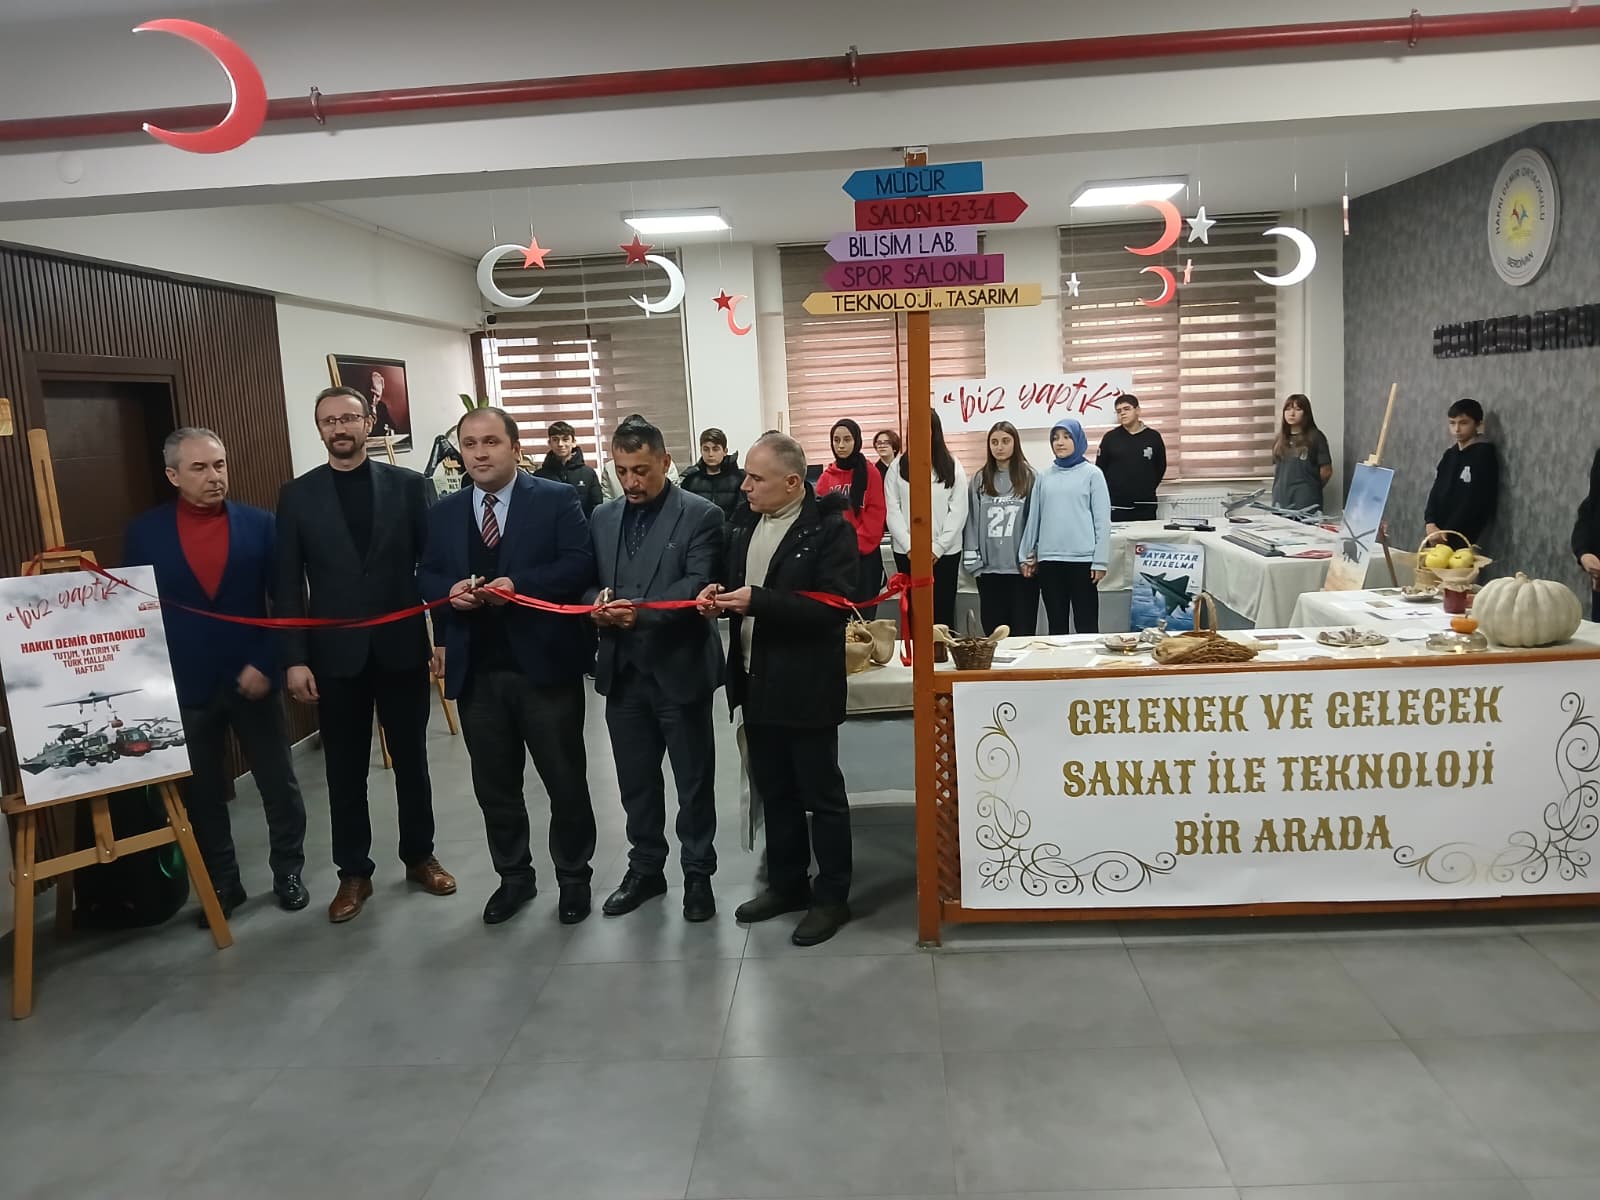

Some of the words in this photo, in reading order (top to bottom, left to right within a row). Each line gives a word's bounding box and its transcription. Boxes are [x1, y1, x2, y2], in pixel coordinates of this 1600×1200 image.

[875, 168, 946, 196] MÜDÜR
[868, 202, 932, 226] SALON
[937, 198, 997, 222] 1-2-3-4
[849, 232, 912, 258] BİLİŞİM
[918, 232, 958, 254] LAB.
[841, 264, 894, 288] SPOR
[903, 260, 988, 284] SALONU
[832, 289, 933, 312] TEKNOLOJİ
[946, 287, 1019, 307] TASARIM
[987, 505, 1020, 538] 27
[1142, 559, 1195, 570] KIZILELMA
[20, 640, 54, 654] HAKKI
[55, 634, 88, 649] DEMİR
[89, 628, 146, 645] ORTAOKULU
[80, 645, 110, 657] YATIRIM
[110, 644, 121, 652] VE
[75, 663, 105, 675] HAFTASI
[83, 653, 114, 665] MALLARI
[1068, 695, 1249, 736] GELENEK
[1259, 693, 1313, 730] VE
[1326, 685, 1504, 729] GELECEK
[1062, 759, 1196, 798] SANAT
[1208, 750, 1266, 794] İLE
[1277, 740, 1495, 792] TEKNOLOJİ
[1175, 812, 1242, 856] BİR
[1252, 815, 1394, 853] ARADA
